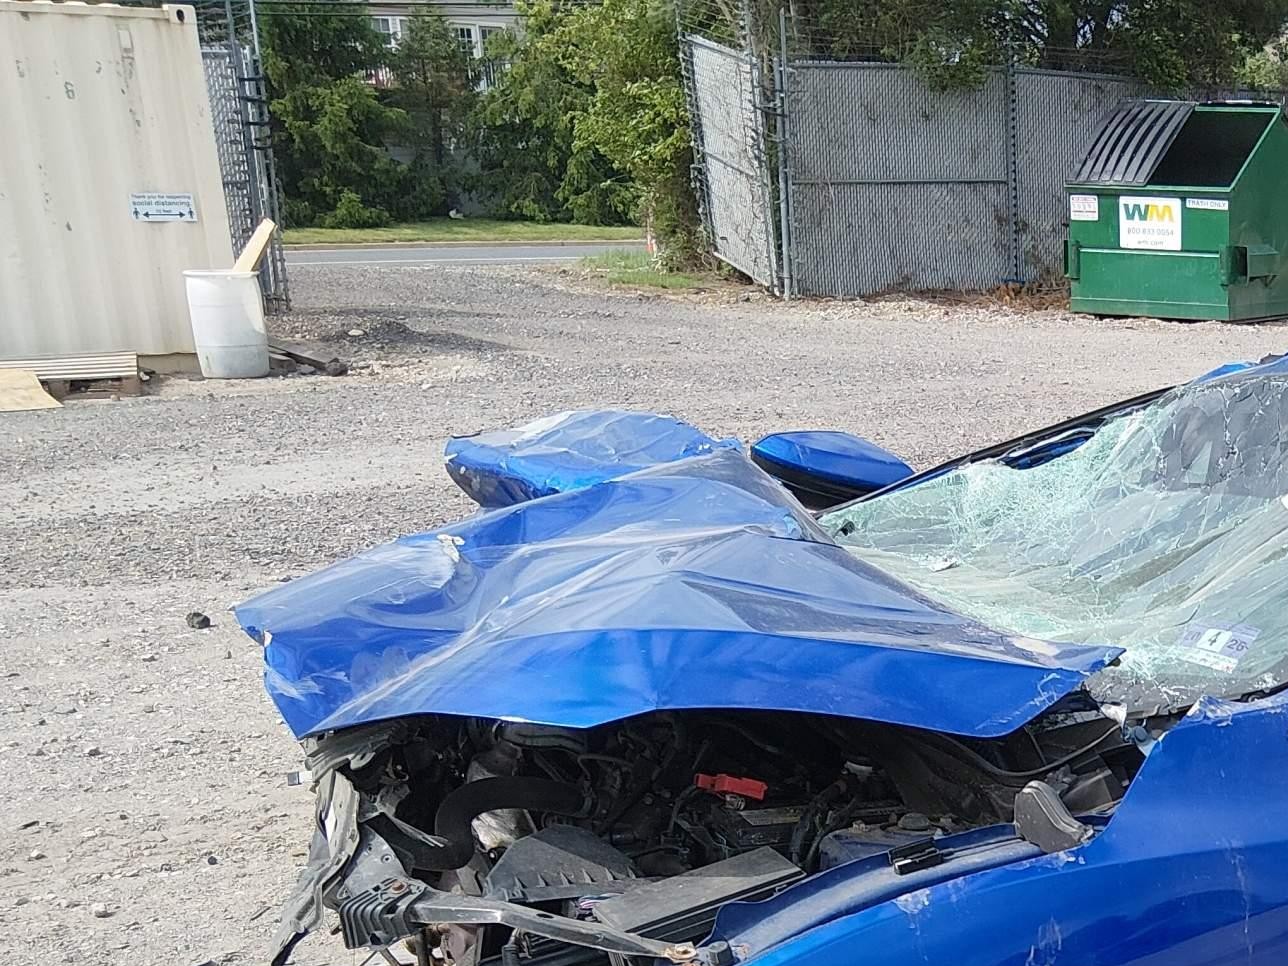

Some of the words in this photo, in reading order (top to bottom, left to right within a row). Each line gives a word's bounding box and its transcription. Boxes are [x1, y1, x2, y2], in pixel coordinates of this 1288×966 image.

[1187, 199, 1209, 207] TRASH
[1123, 203, 1174, 223] WM
[1207, 631, 1222, 646] 4
